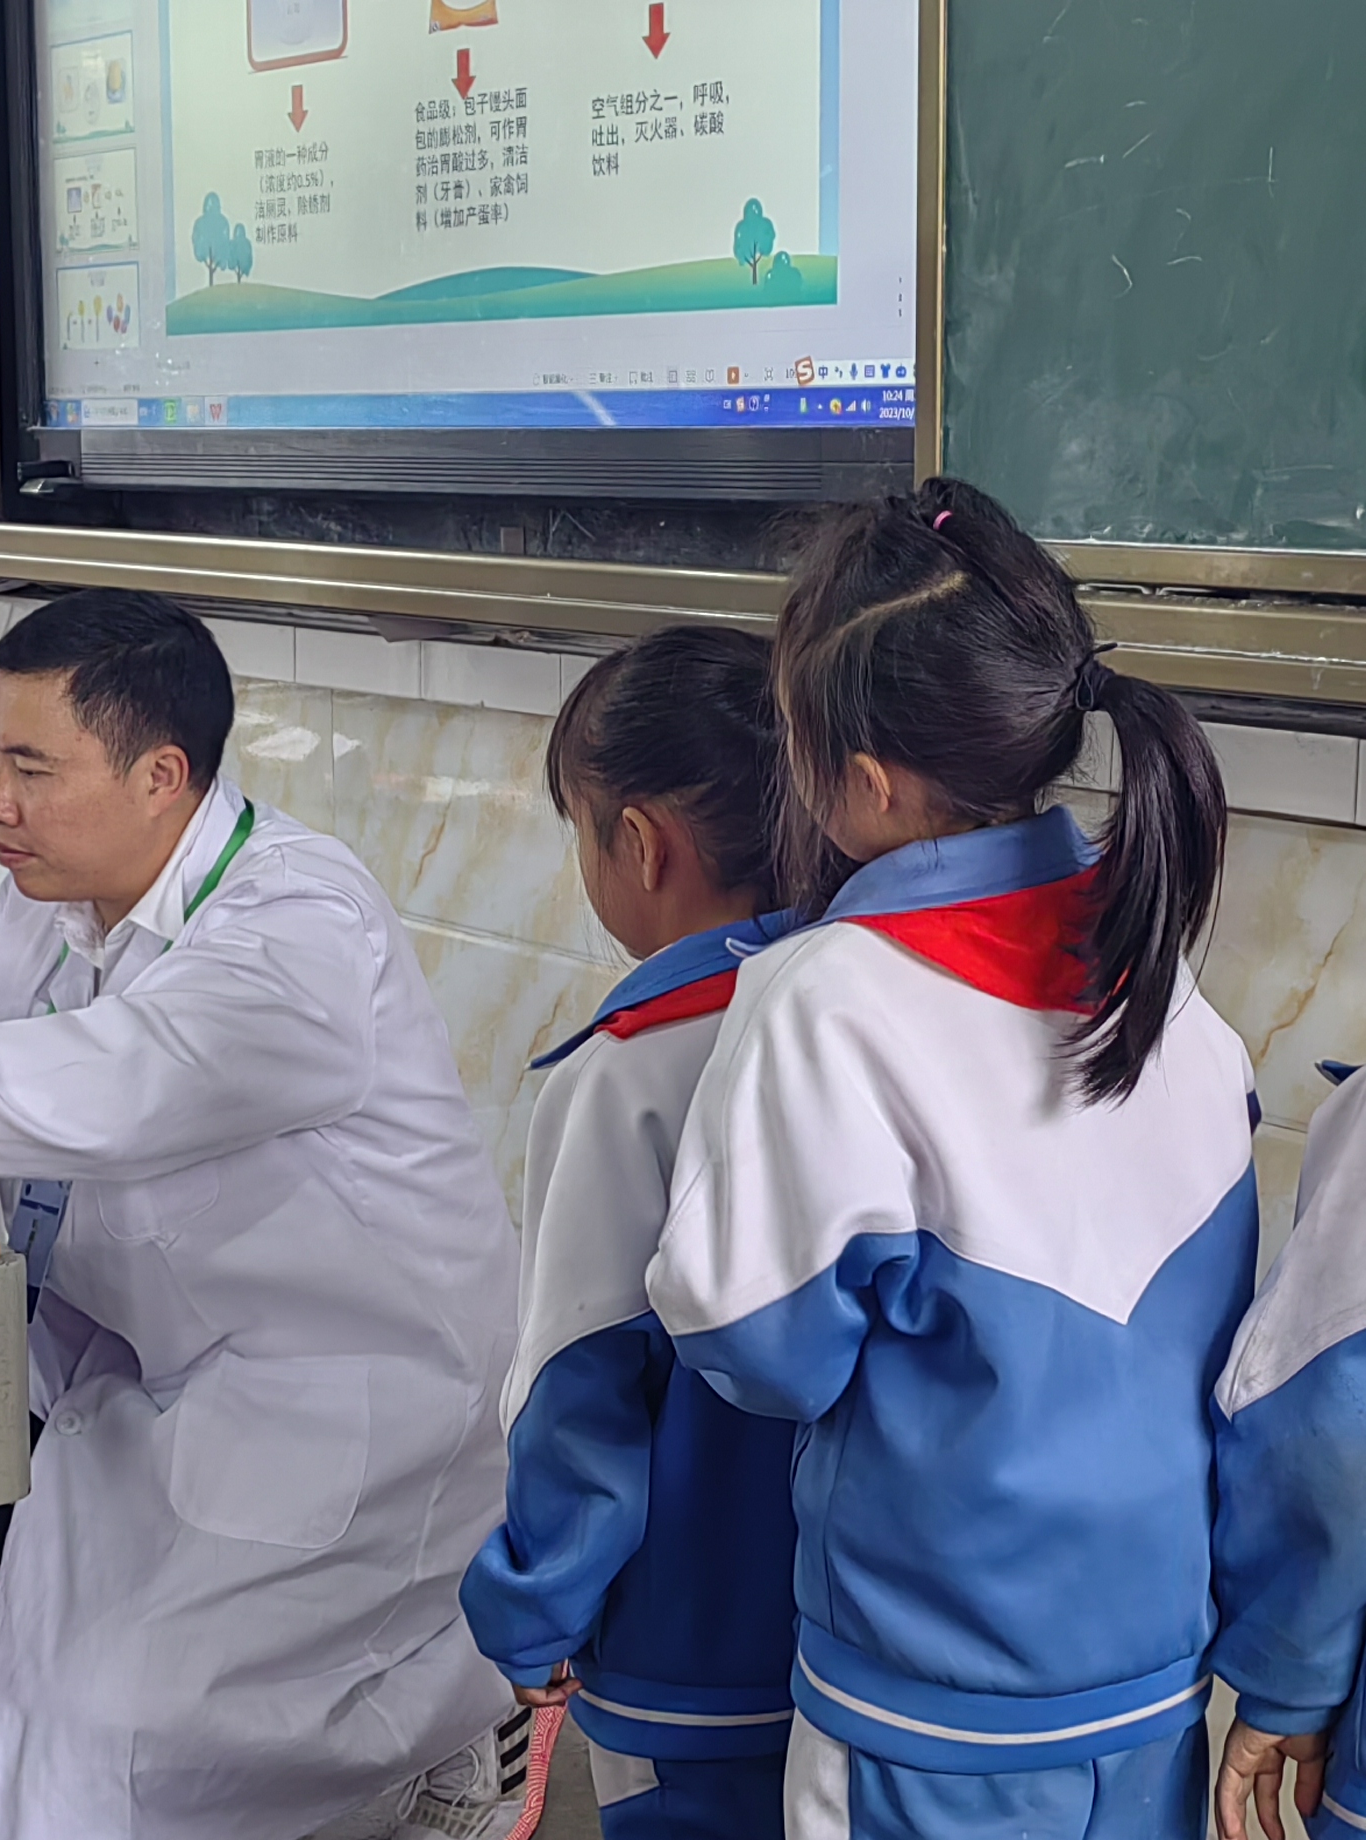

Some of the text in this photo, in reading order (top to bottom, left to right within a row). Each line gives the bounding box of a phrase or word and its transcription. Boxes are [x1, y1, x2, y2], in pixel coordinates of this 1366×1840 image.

[254, 141, 329, 169] 胃液的一种成分
[591, 152, 620, 177] 饮料
[255, 222, 299, 244] 制作原料
[881, 389, 903, 403] 10:24
[879, 406, 915, 421] 2023/10/
